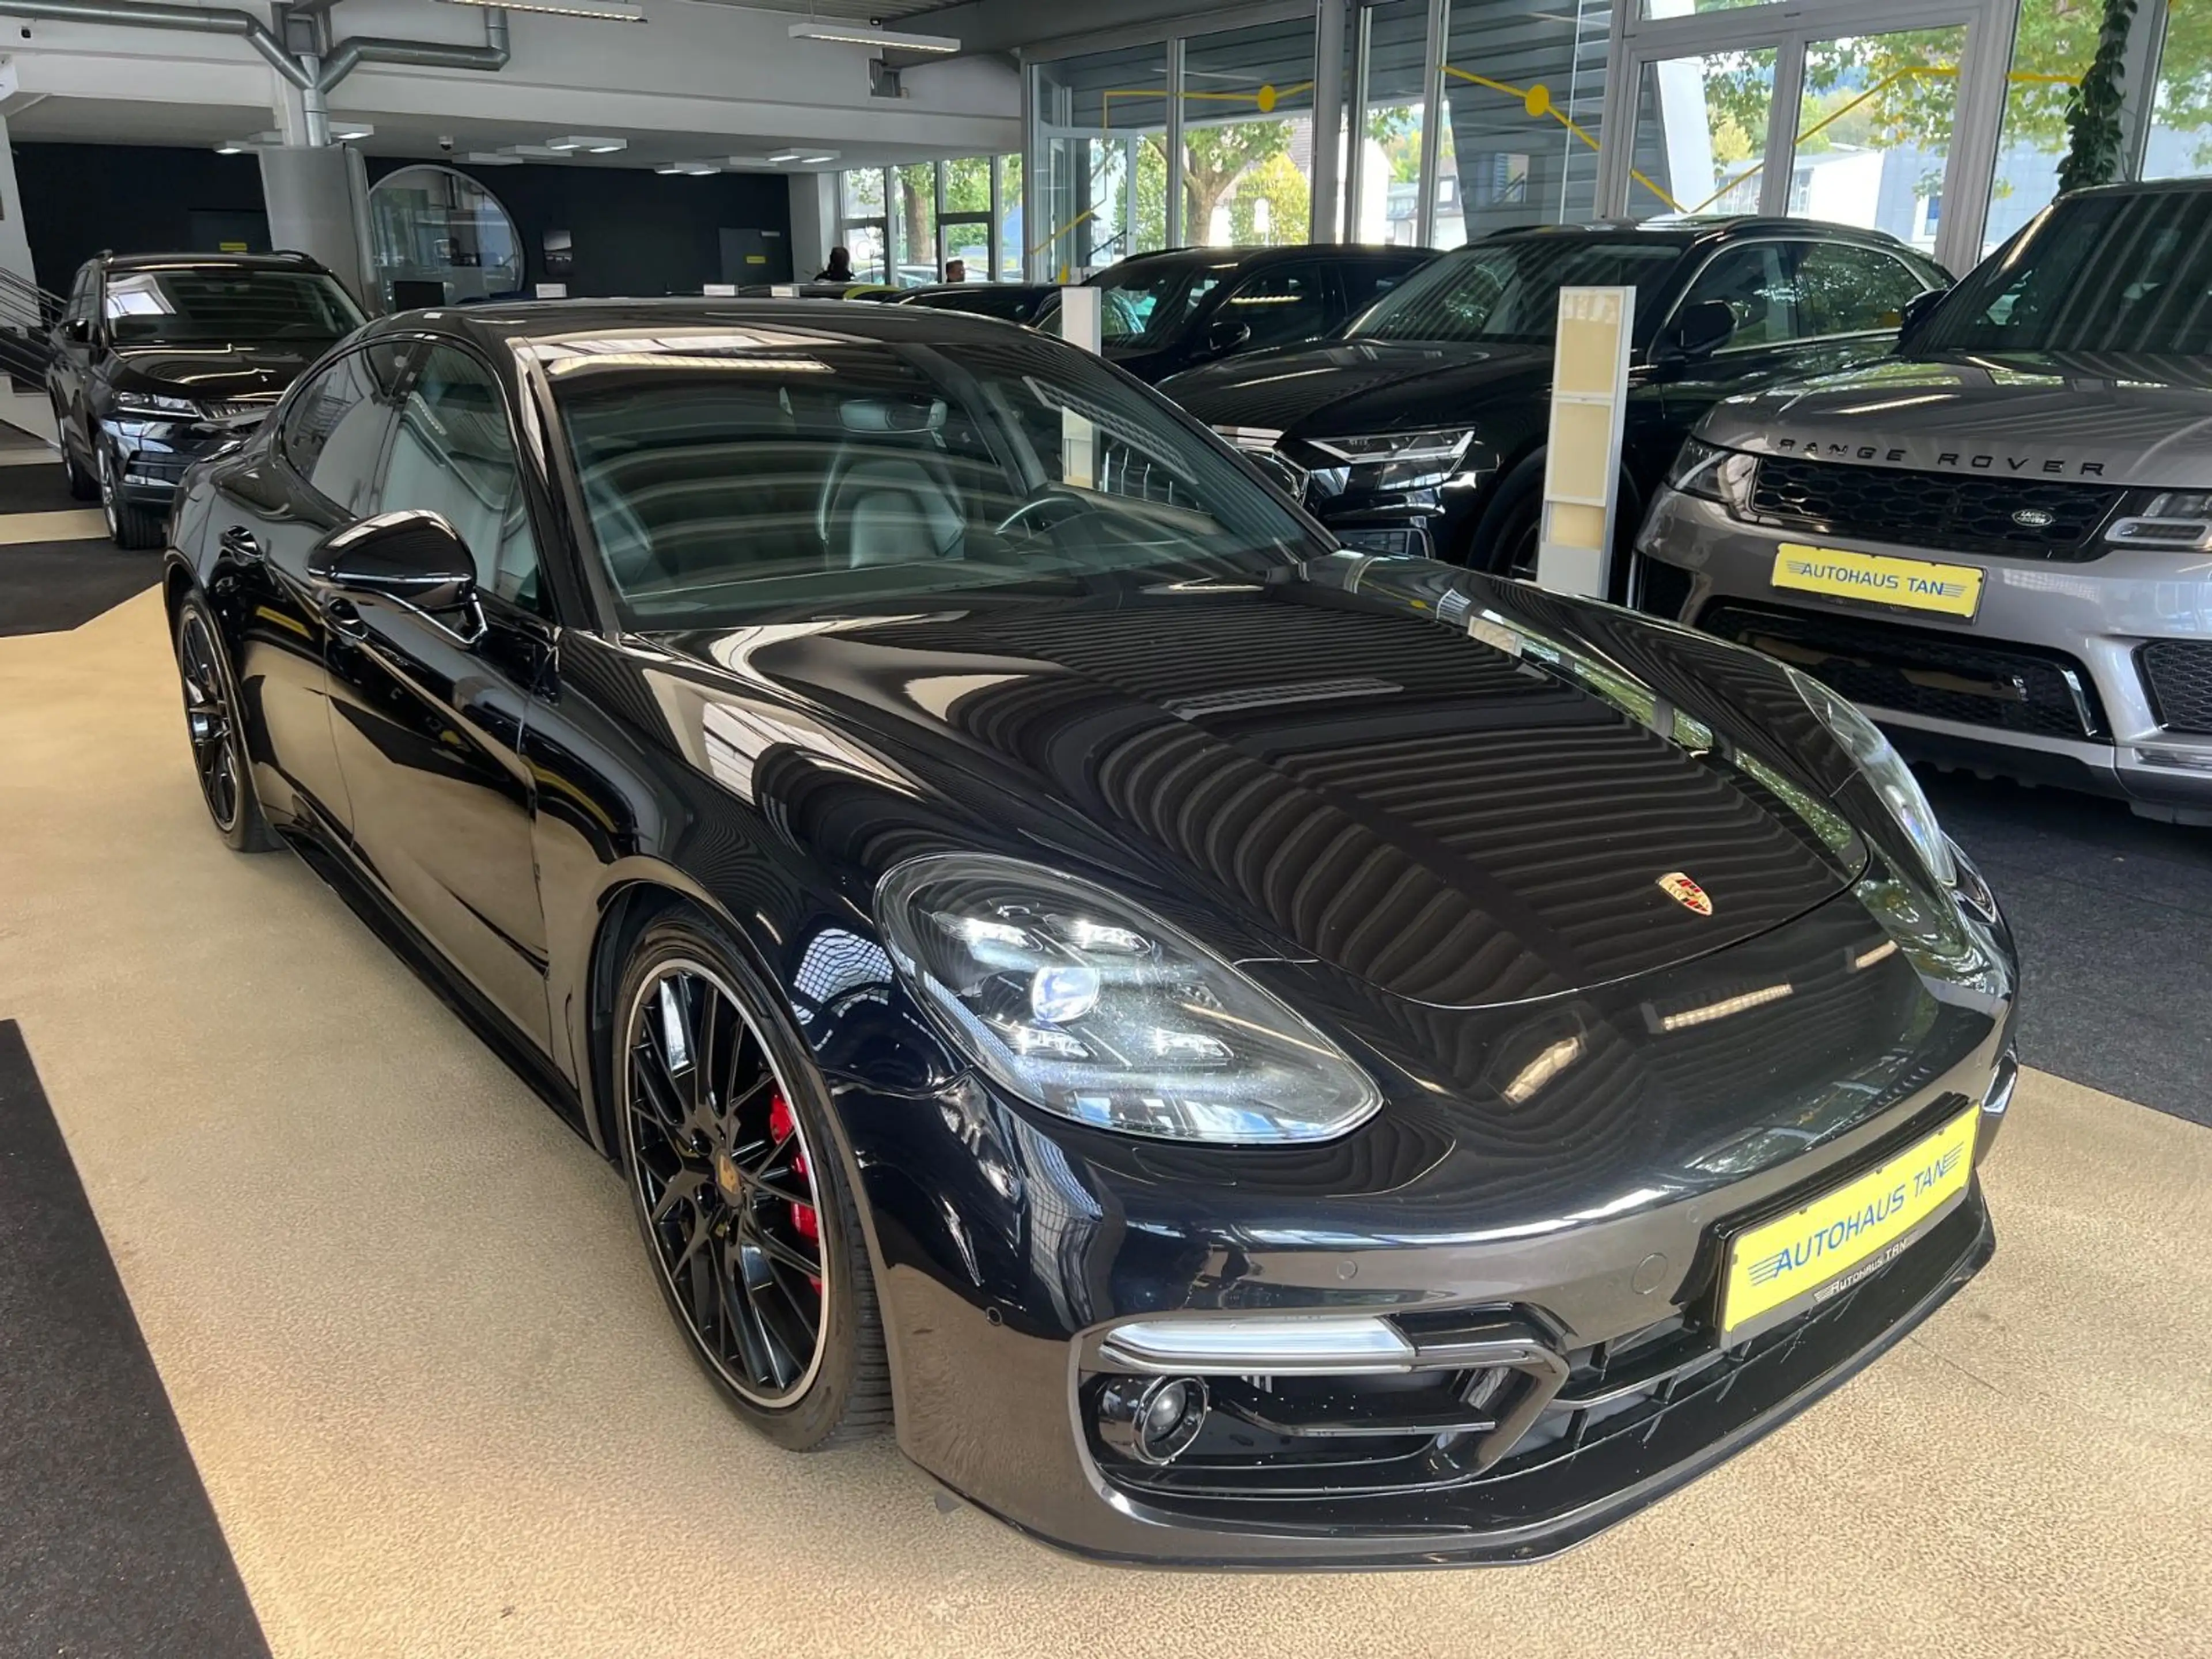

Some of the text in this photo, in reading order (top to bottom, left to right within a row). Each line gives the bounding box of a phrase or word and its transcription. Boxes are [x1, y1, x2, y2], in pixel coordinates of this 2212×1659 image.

[1778, 438, 2104, 476] RANGE ROVER
[1801, 562, 1944, 596] AUTOHAUS TAN
[1774, 1158, 1946, 1278] AUTOHAUS TAN
